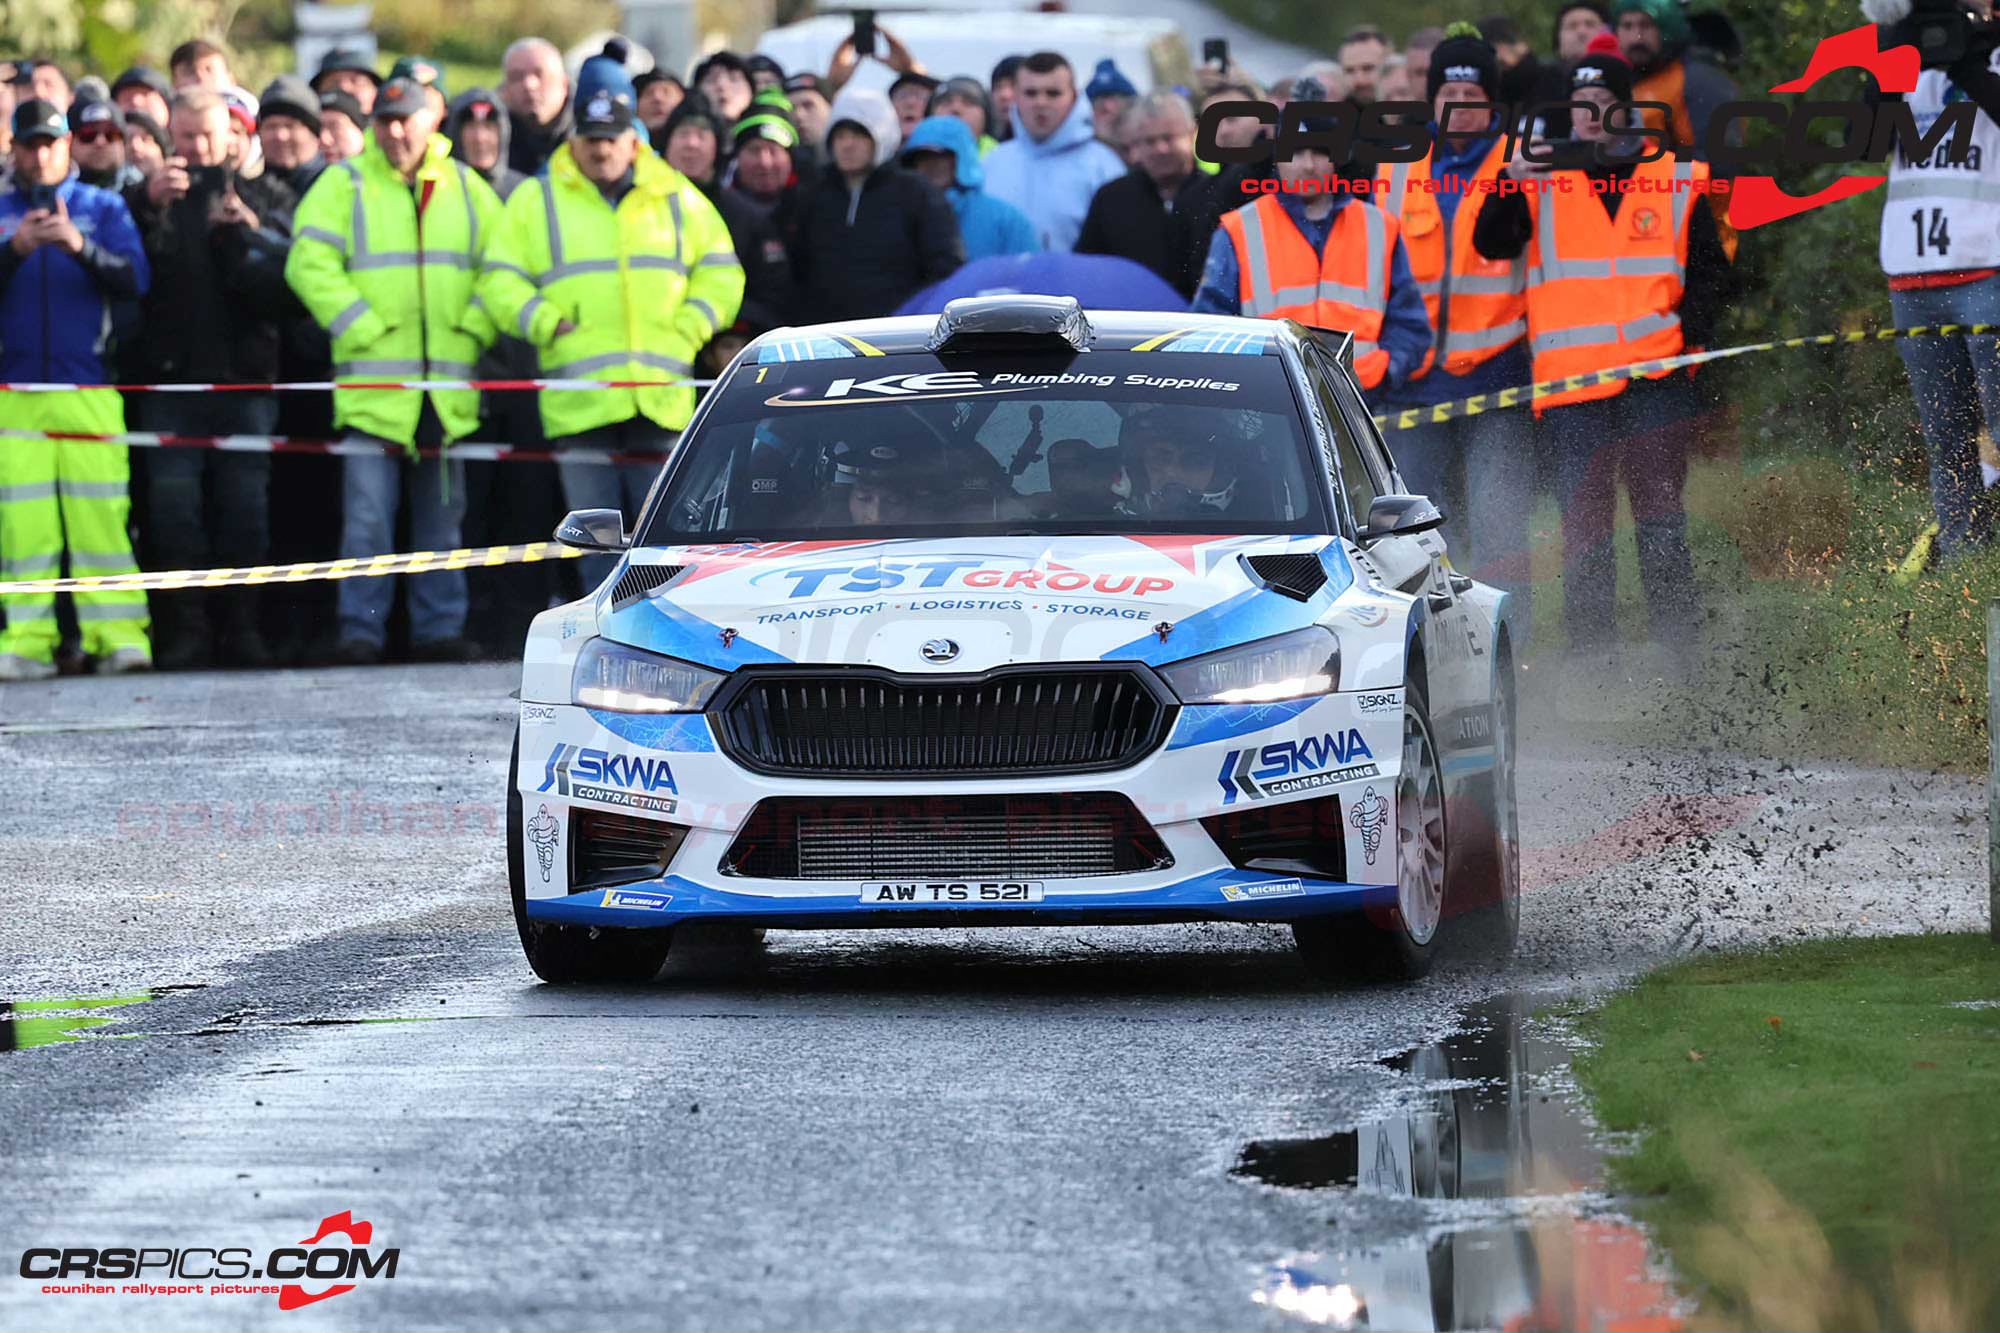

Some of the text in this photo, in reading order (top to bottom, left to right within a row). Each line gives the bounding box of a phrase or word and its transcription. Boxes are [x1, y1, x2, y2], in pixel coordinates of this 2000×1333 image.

[1911, 209, 1951, 256] 14
[755, 367, 768, 383] 1
[824, 371, 1241, 397] KE Plumbing Supplies
[757, 600, 1151, 624] TRANSPORT LOGISTICS STORAGE
[1252, 728, 1373, 780] SKWA
[570, 748, 679, 795] SKWA
[1271, 768, 1375, 794] CONTRACTING
[577, 788, 672, 811] CONTRACTING
[876, 884, 1029, 901] AW TS 521
[1248, 883, 1300, 895] MICHELIN
